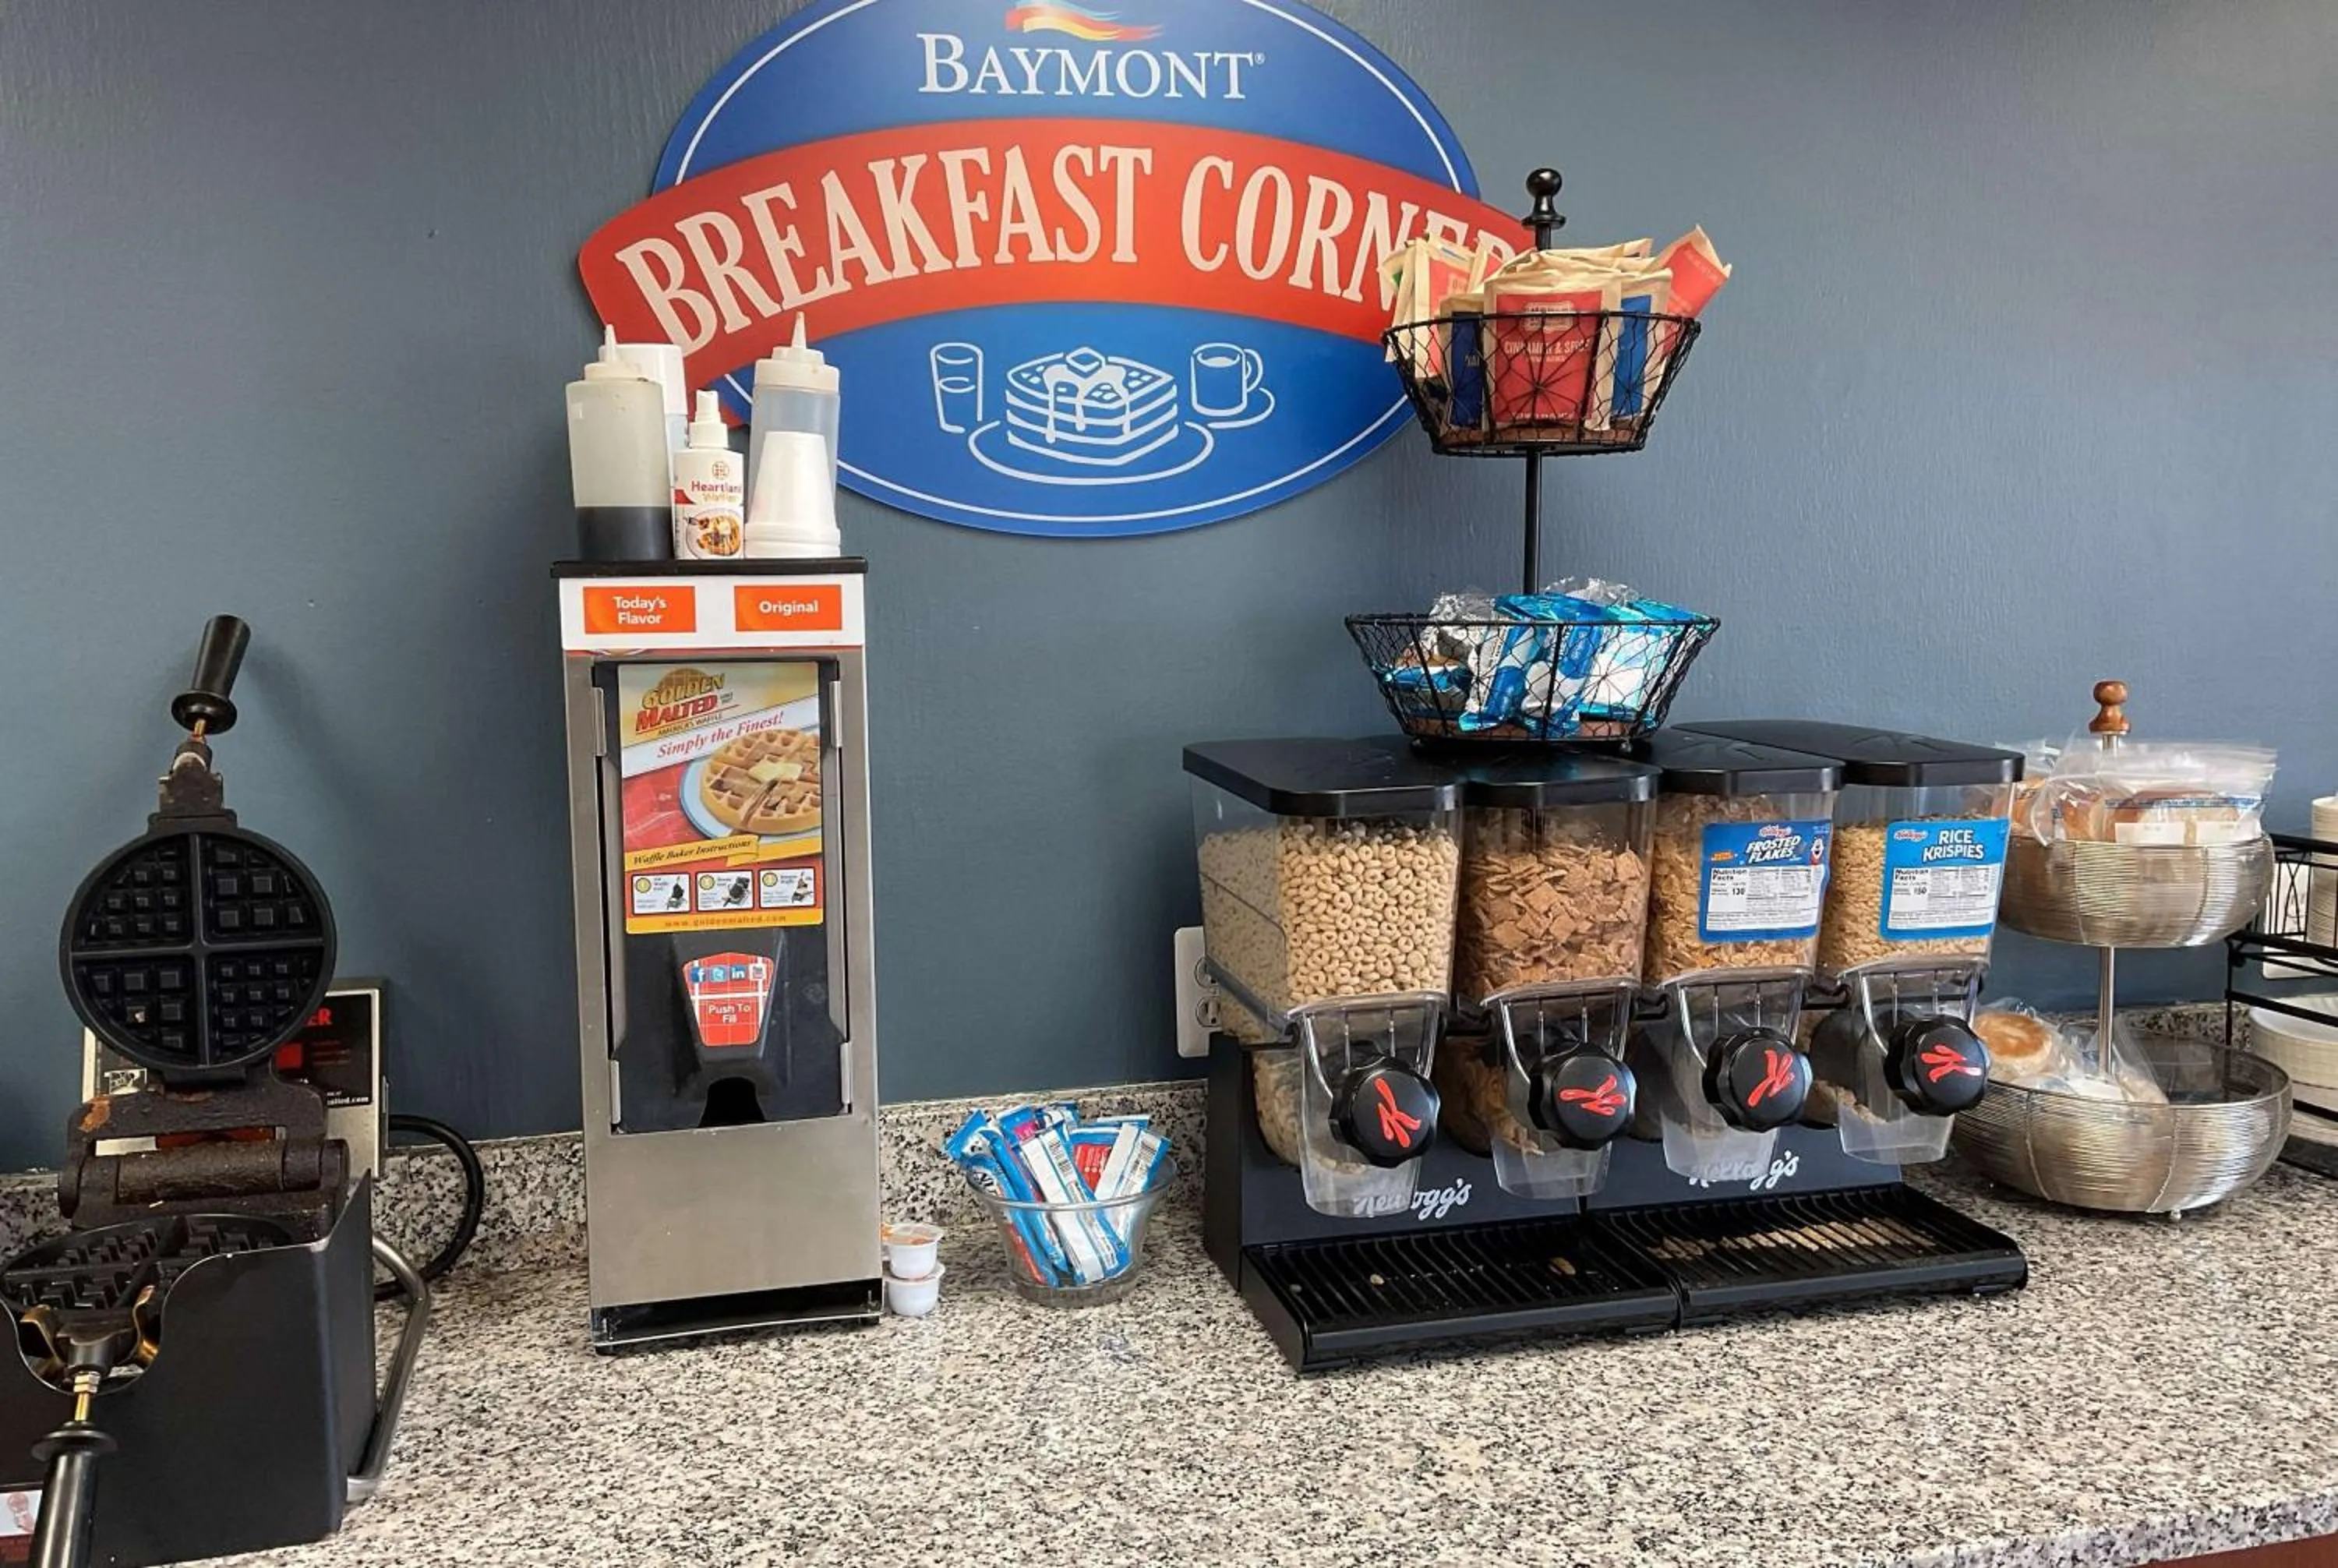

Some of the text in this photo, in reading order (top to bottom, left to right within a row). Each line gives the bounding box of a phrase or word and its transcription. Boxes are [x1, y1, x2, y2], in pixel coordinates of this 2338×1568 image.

[615, 143, 1517, 358] BREAKFAST CORN
[613, 595, 666, 612] Today's
[759, 599, 818, 616] Original
[617, 611, 662, 625] Flavor
[641, 673, 726, 709] GOLDEN
[635, 694, 719, 733] MALTED
[657, 710, 784, 758] Simply the Finest!
[1746, 835, 1801, 854] FROSTED
[1938, 828, 1974, 846] RICE
[634, 839, 752, 865] Waffle Baker Instructions
[1748, 846, 1794, 864] FLAKES
[1923, 844, 1985, 863] KRISPIES
[708, 1003, 751, 1014] Push To
[722, 1014, 738, 1023] Fill
